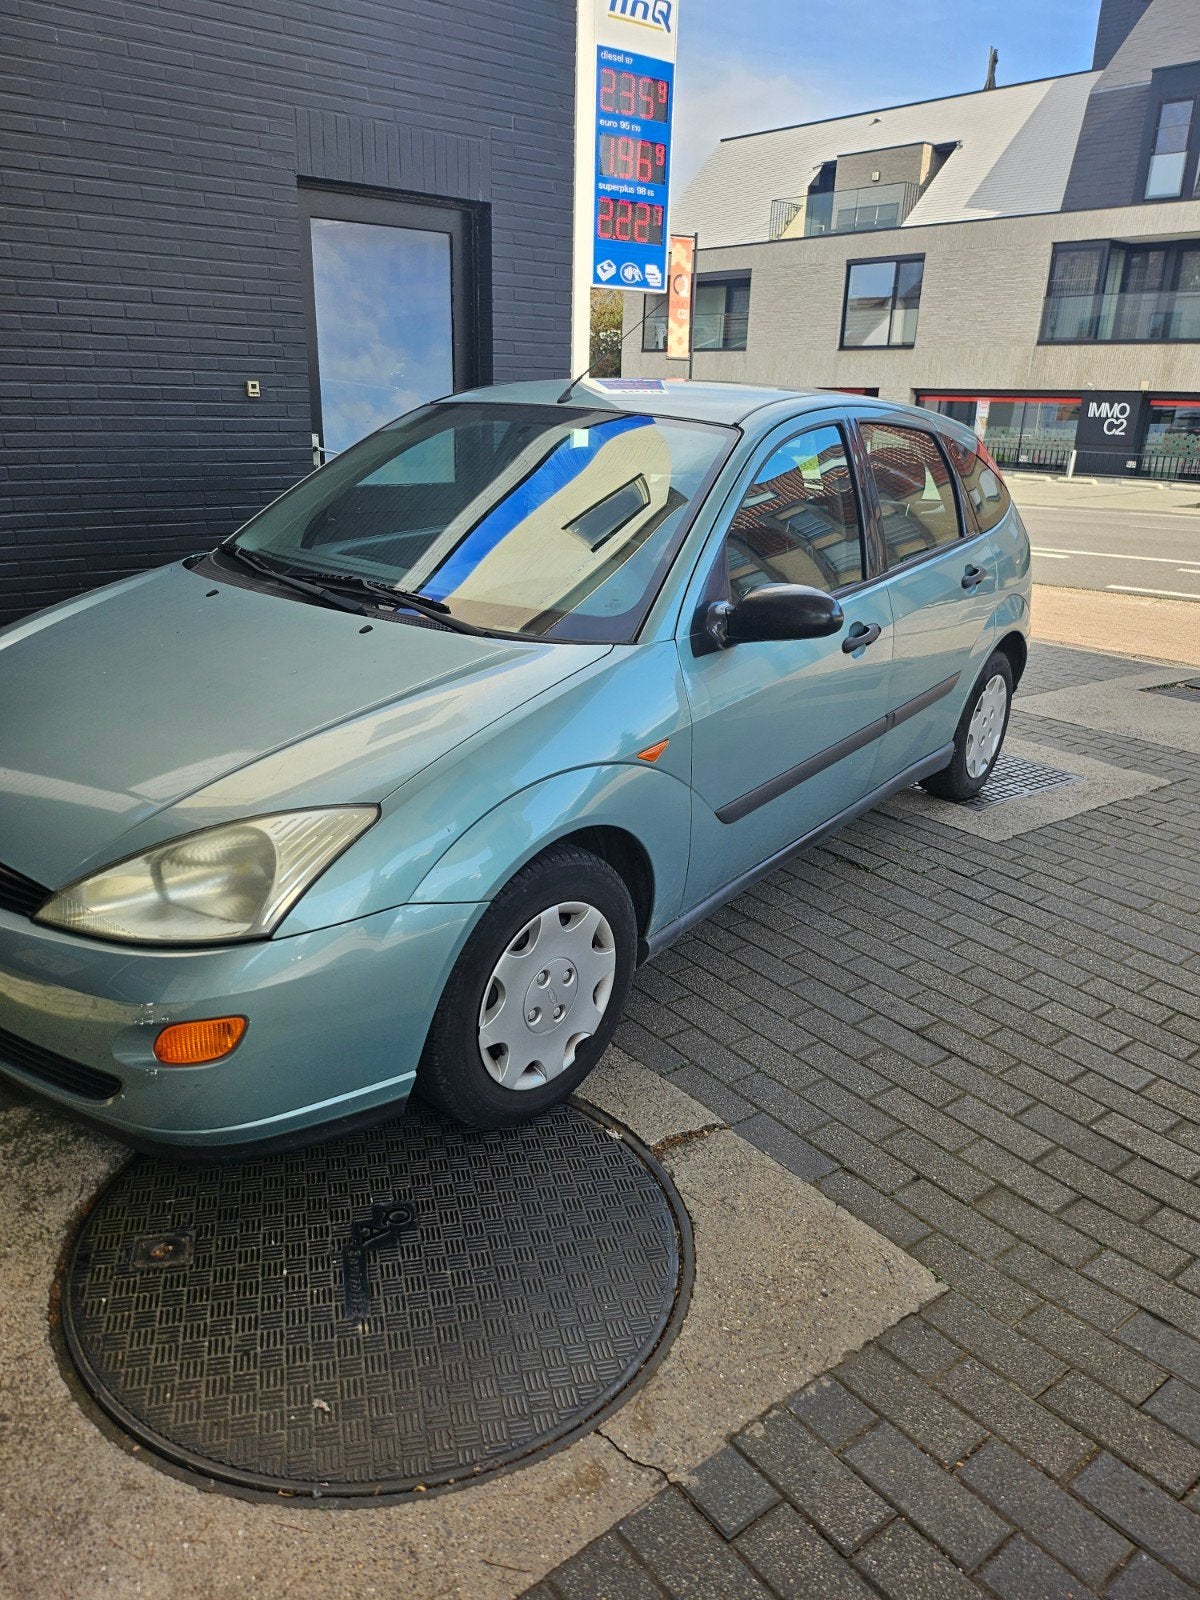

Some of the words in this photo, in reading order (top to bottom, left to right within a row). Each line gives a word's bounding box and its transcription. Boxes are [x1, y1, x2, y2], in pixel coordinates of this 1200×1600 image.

[600, 50, 624, 63] diesel
[599, 118, 618, 128] euro
[619, 120, 630, 130] 95
[598, 182, 635, 194] superplus
[636, 187, 647, 196] 98
[1087, 402, 1131, 419] IMMO
[1103, 418, 1128, 436] C2
